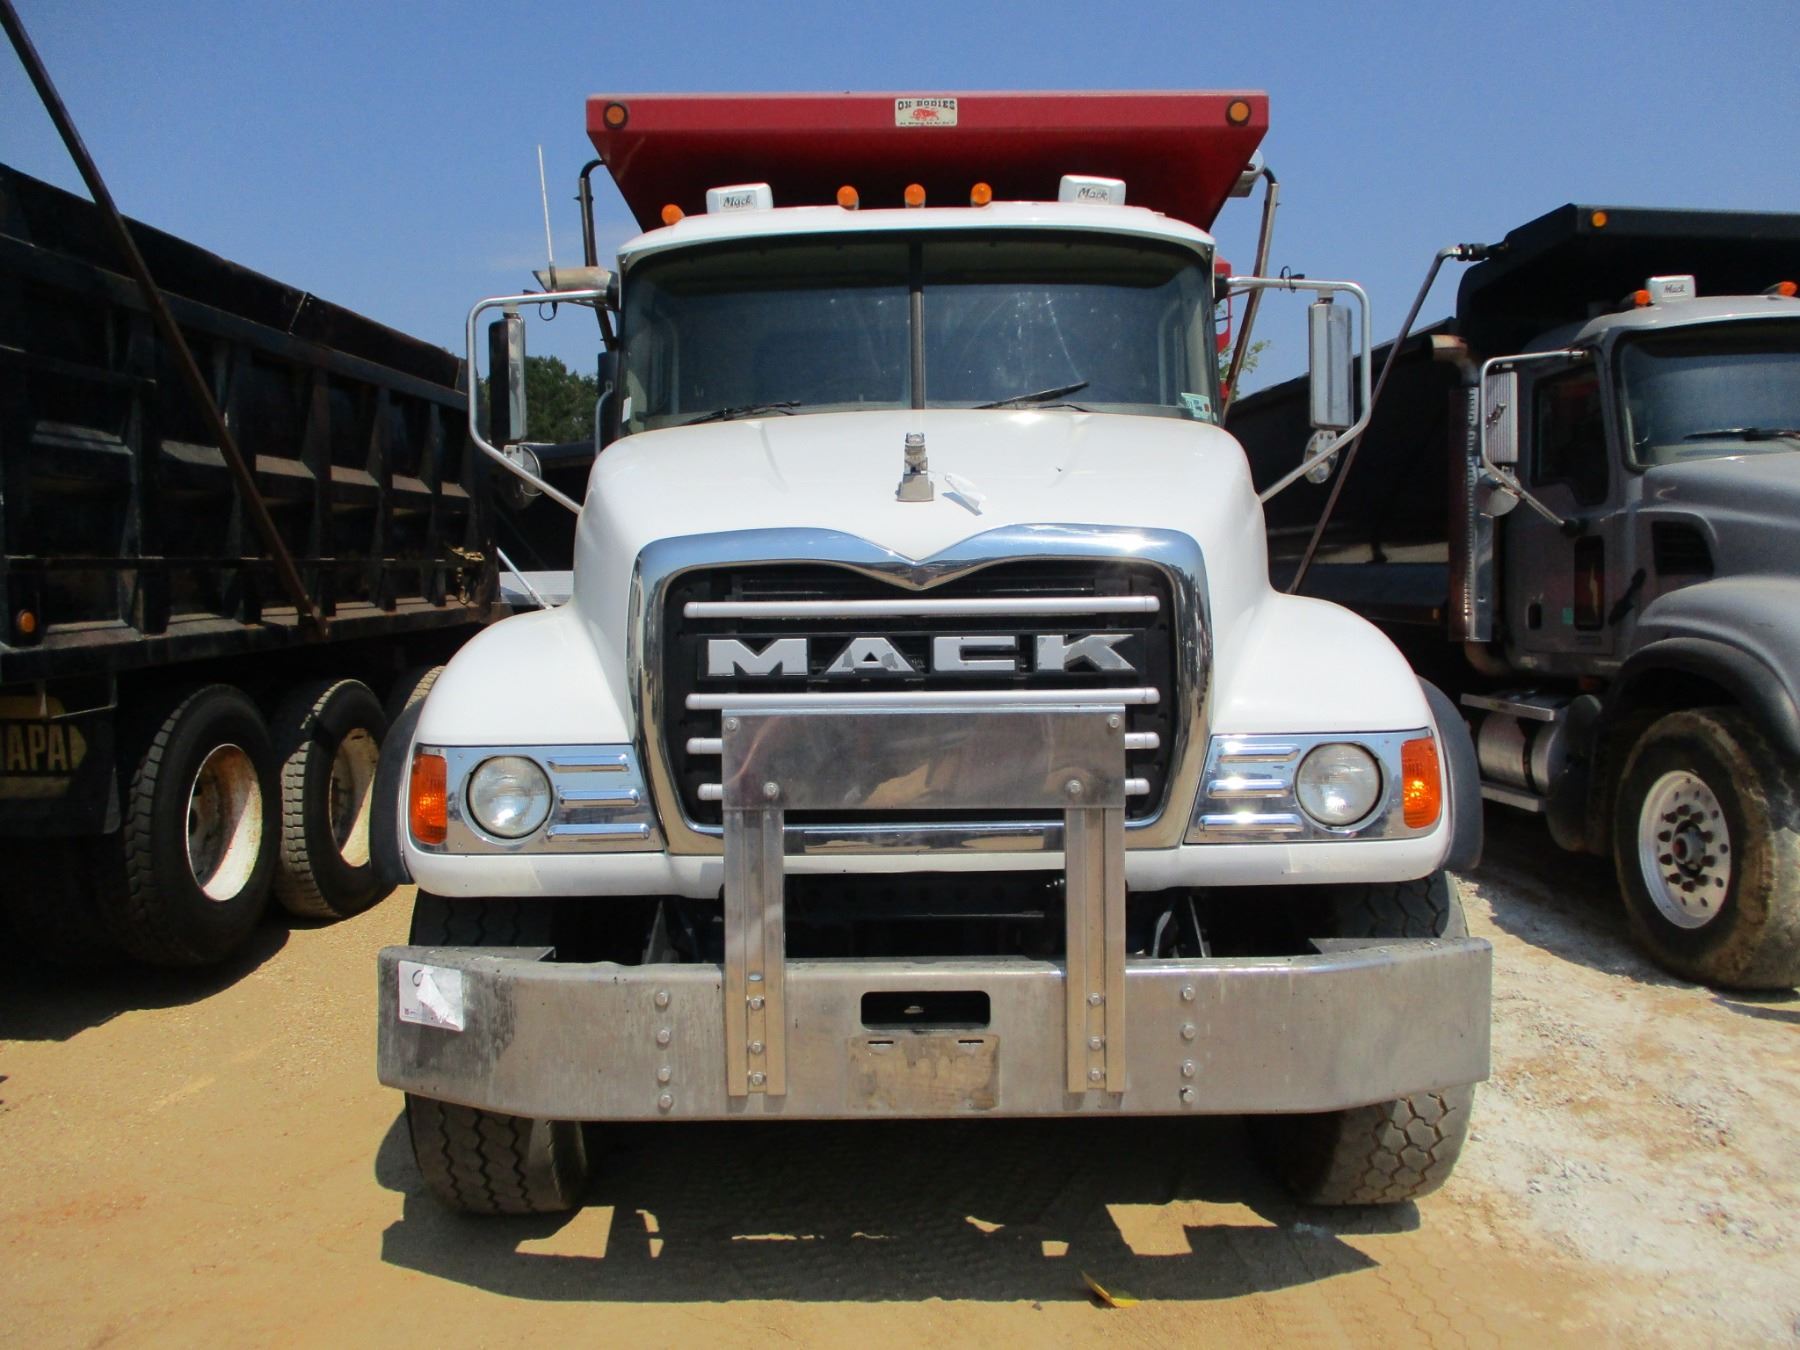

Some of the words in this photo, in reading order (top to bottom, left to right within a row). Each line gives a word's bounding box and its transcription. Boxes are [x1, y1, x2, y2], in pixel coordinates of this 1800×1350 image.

[723, 195, 753, 207] Mack
[707, 632, 1137, 677] MACK
[0, 724, 69, 771] APA
